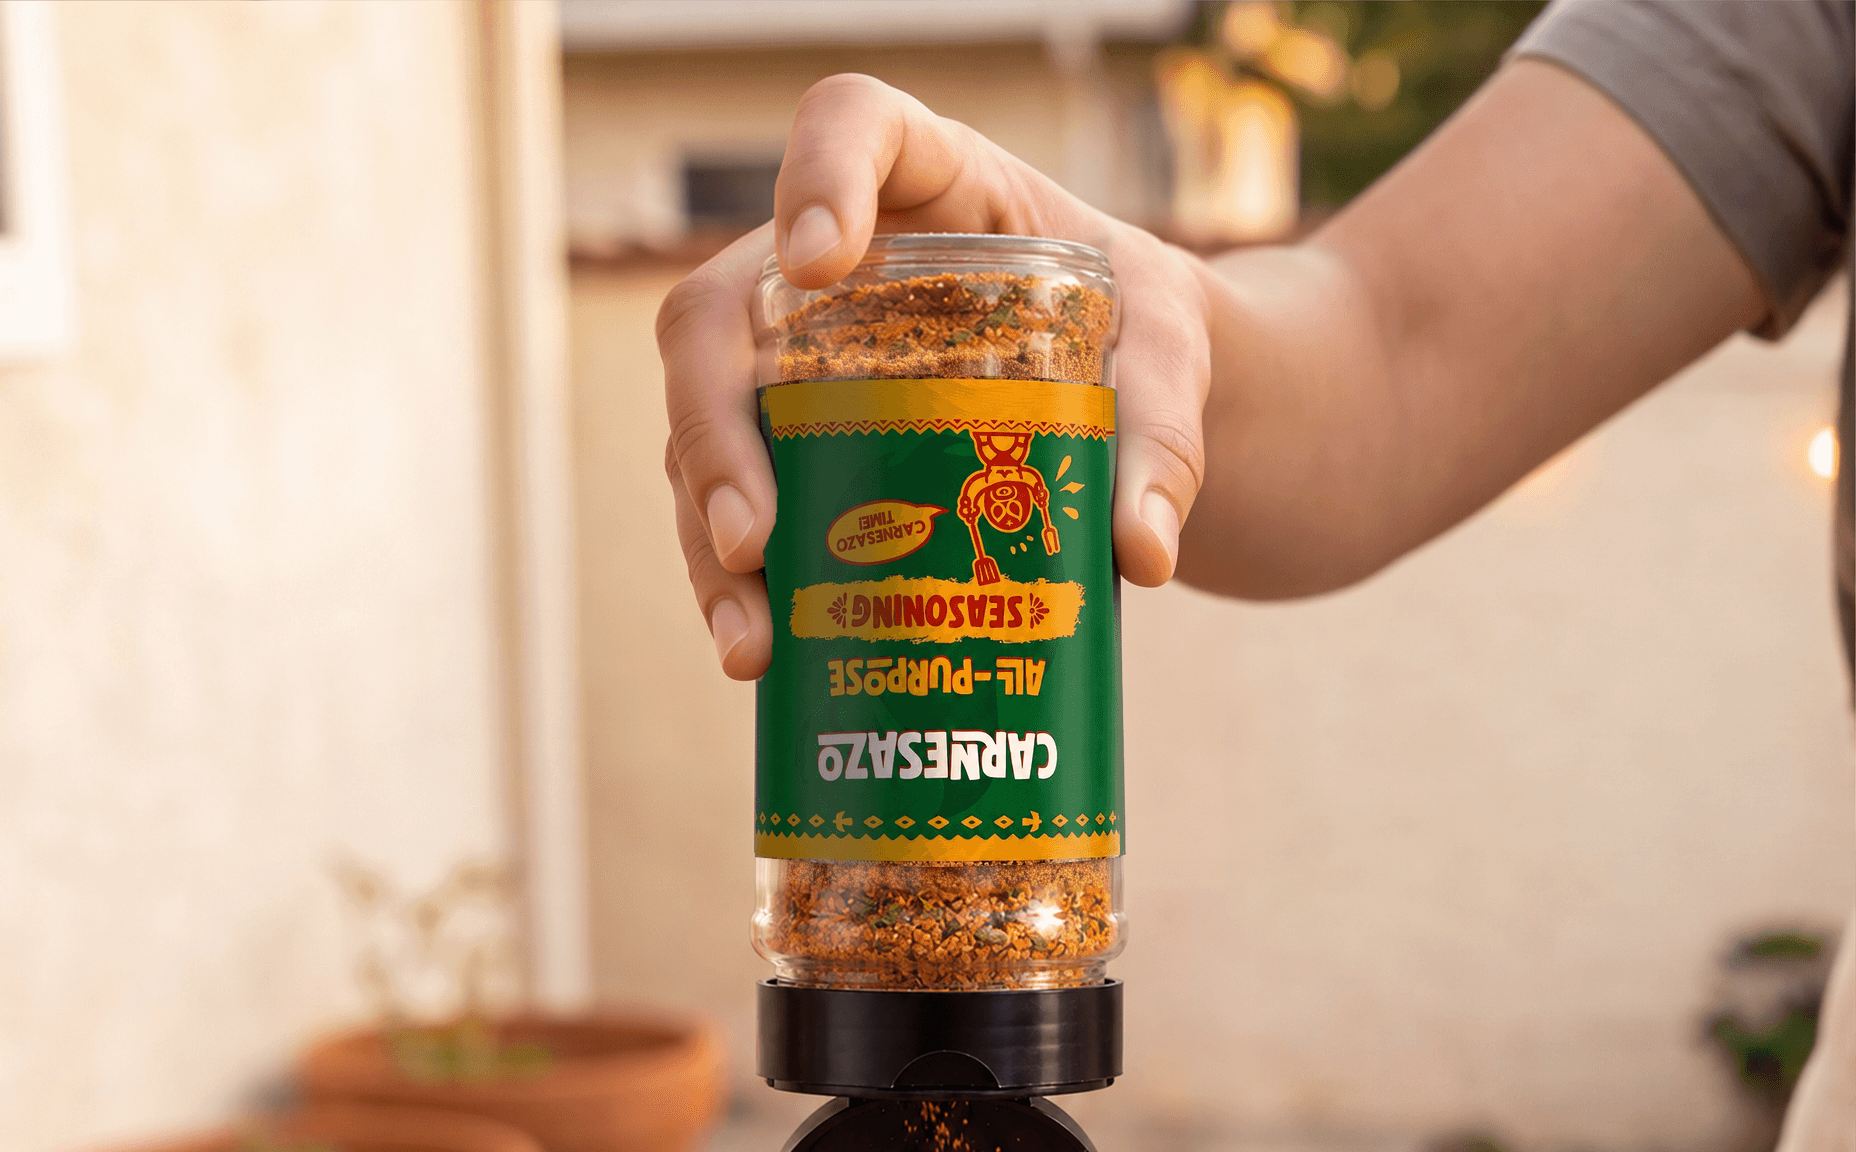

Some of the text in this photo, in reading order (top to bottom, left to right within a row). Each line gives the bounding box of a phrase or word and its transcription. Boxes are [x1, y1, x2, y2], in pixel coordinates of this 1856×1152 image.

[836, 520, 926, 552] CARNESAZO
[858, 509, 896, 531] TIME!
[851, 594, 1023, 629] SEASONING
[828, 655, 1046, 696] ALL-PURPOSE
[817, 730, 1058, 781] CARNESAZO
